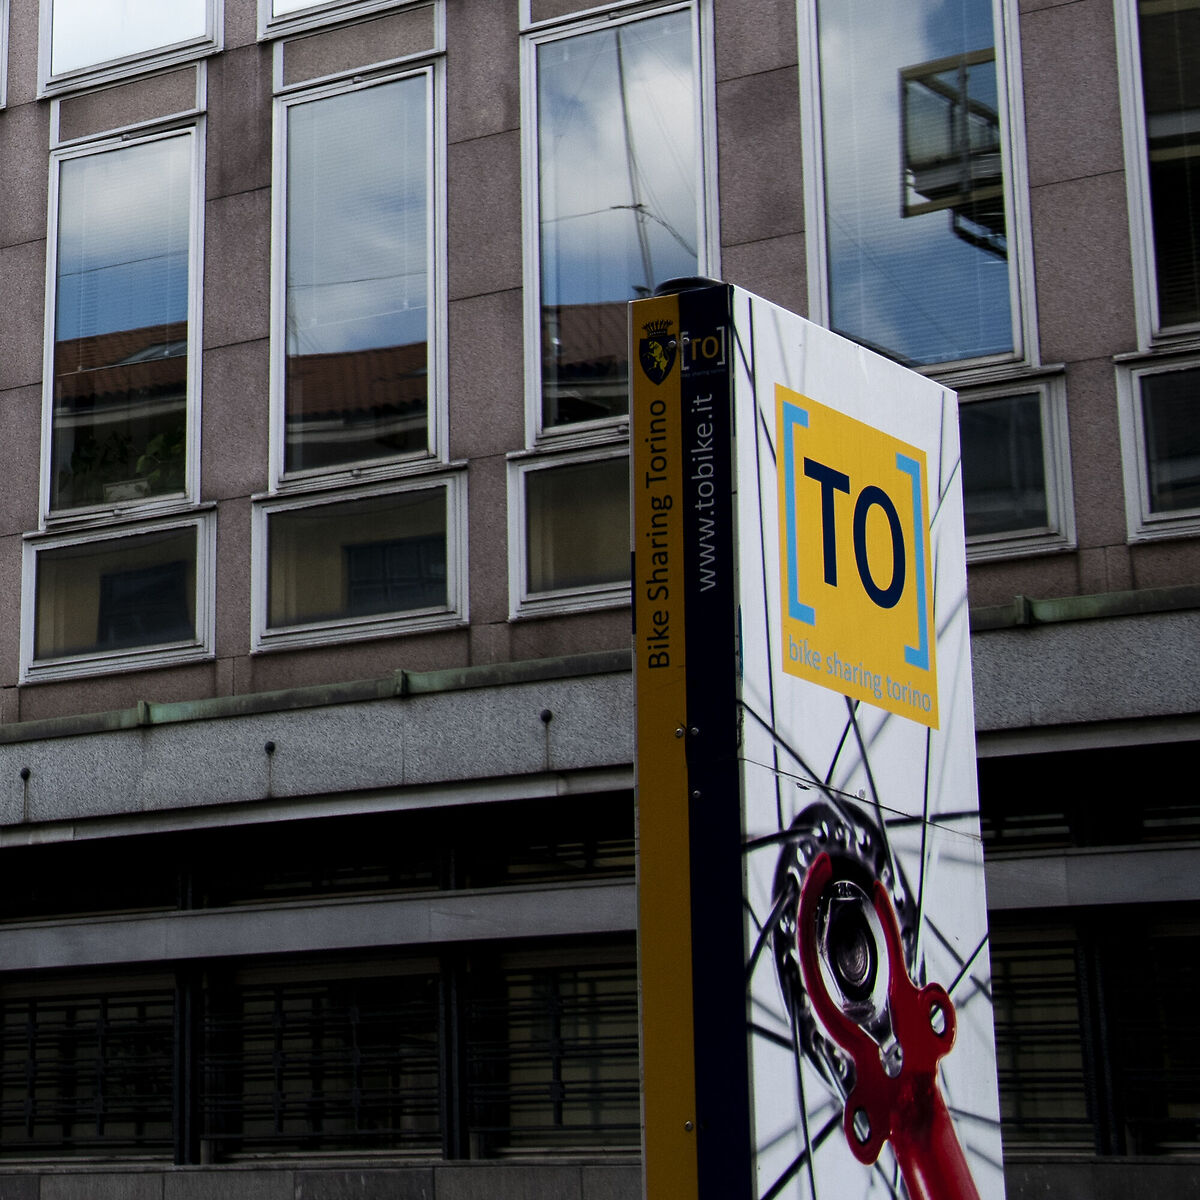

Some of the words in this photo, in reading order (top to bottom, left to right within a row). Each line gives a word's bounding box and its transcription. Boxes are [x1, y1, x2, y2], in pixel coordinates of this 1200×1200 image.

[645, 399, 667, 489] Torino
[691, 393, 716, 592] www.tobike.it
[647, 494, 673, 601] Sharing
[648, 610, 670, 669] Bike
[788, 634, 822, 670] bike
[826, 651, 883, 699] sharing
[886, 674, 932, 713] torino
